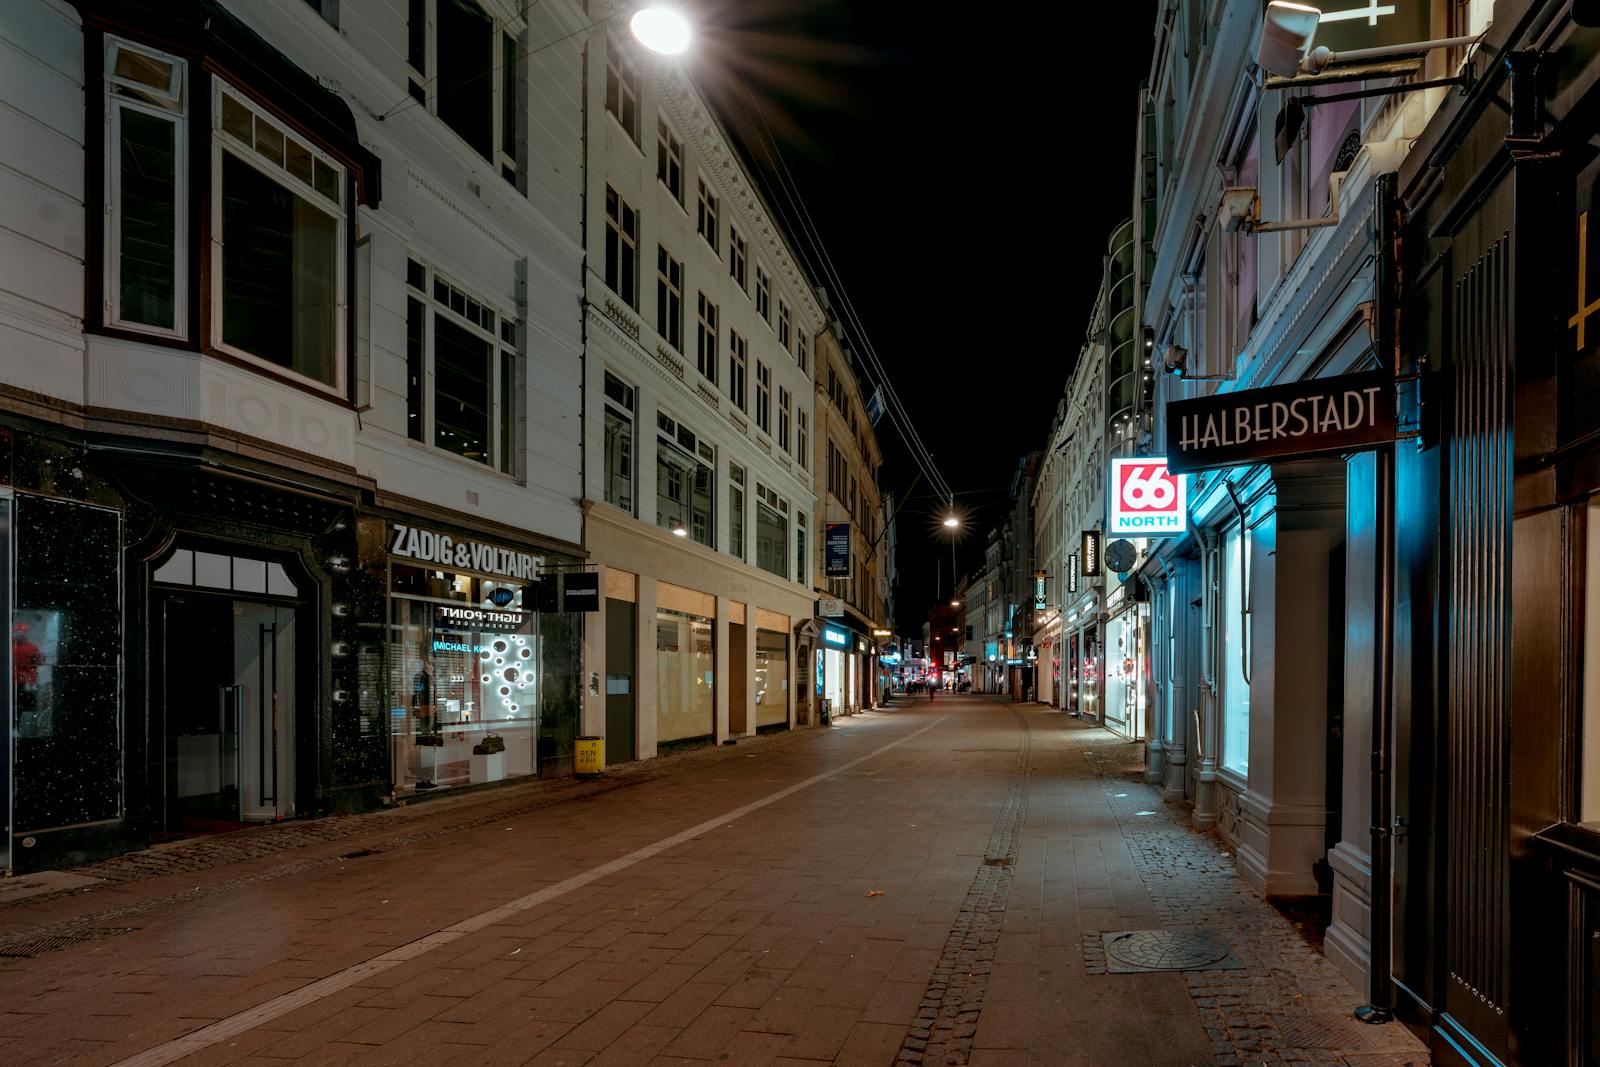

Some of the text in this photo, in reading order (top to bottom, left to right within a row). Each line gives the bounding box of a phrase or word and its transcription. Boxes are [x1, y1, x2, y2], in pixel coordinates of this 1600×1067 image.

[1179, 387, 1380, 451] HALBERSTADT
[1119, 516, 1178, 527] NORTH
[437, 641, 471, 652] MICHAEL
